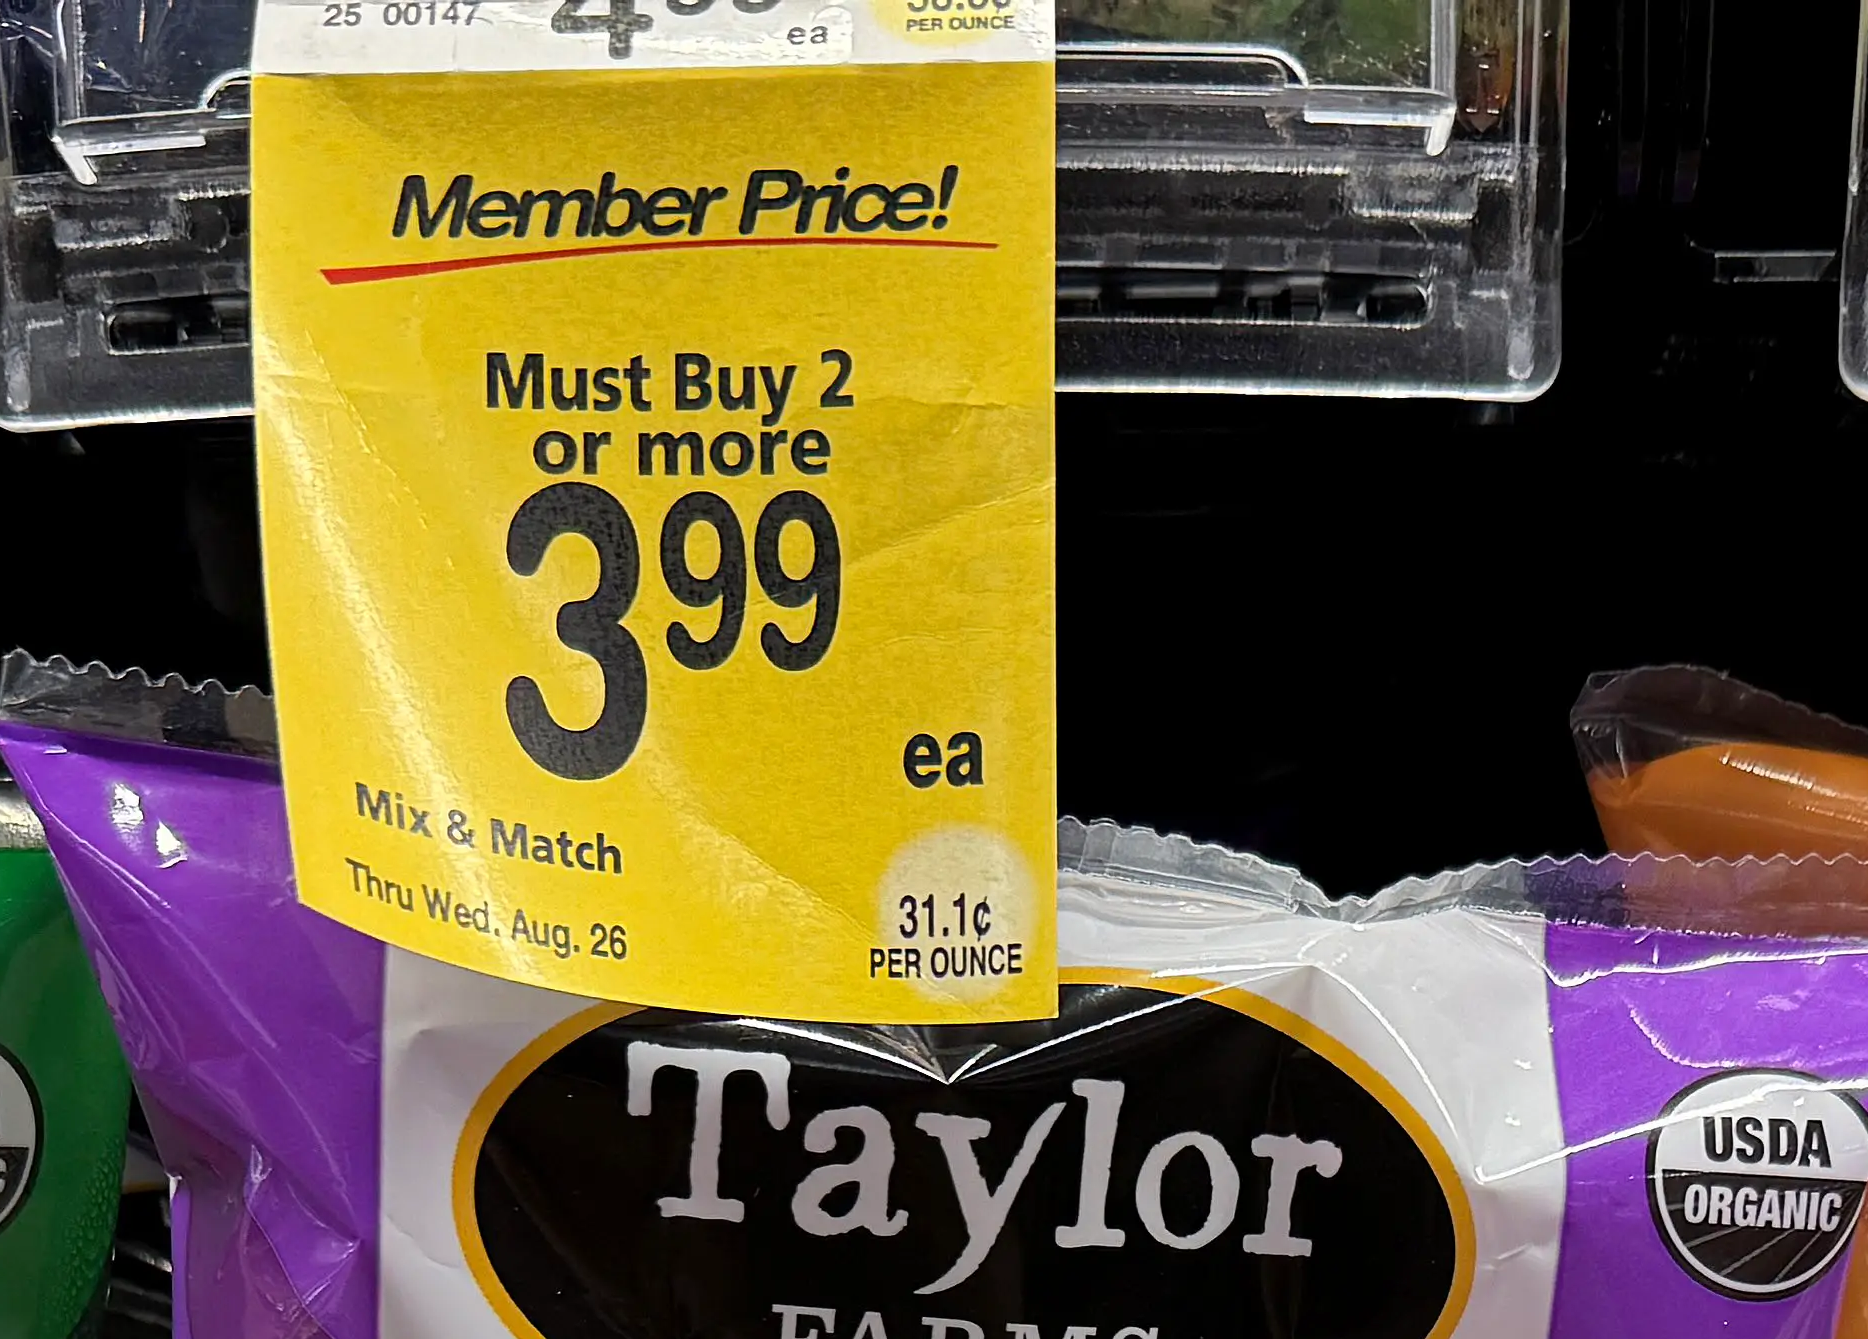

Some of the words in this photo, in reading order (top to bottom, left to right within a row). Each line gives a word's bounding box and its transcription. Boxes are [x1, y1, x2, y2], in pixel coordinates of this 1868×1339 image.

[322, 3, 362, 28] 25
[383, 1, 482, 27] 00147
[485, 351, 652, 412] Must
[675, 352, 797, 427] Buy
[821, 349, 855, 408] 2
[532, 429, 611, 477] or
[637, 428, 831, 476] more
[898, 894, 992, 940] 31.1¢
[869, 947, 923, 980] PER
[930, 944, 1023, 978] OUNCE
[1702, 1115, 1832, 1168] USDA
[626, 1041, 1343, 1295] Taylor
[1683, 1184, 1843, 1232] ORGANIC
